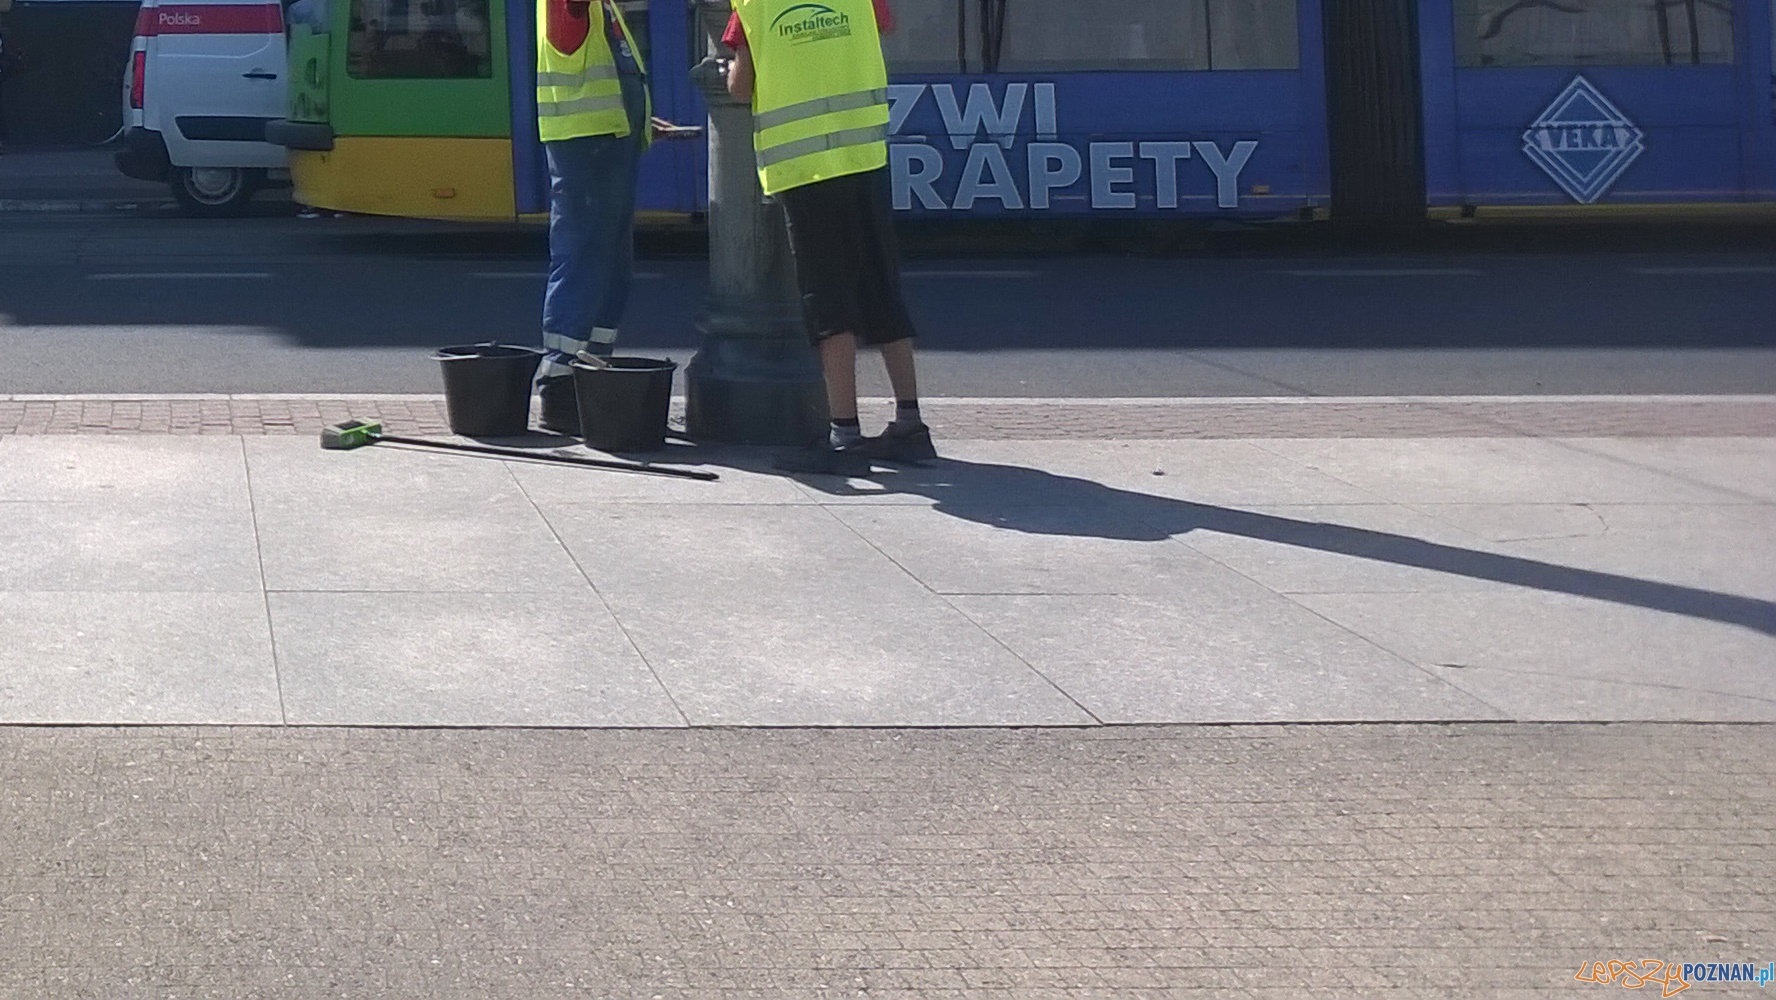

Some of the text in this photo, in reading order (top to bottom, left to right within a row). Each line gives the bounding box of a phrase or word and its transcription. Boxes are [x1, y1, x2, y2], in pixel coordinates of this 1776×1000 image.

[157, 11, 201, 27] Polska
[778, 11, 849, 37] Instaltech
[887, 82, 1059, 150] ZWI
[1546, 122, 1621, 150] VEKA
[888, 139, 1260, 211] RAPETY
